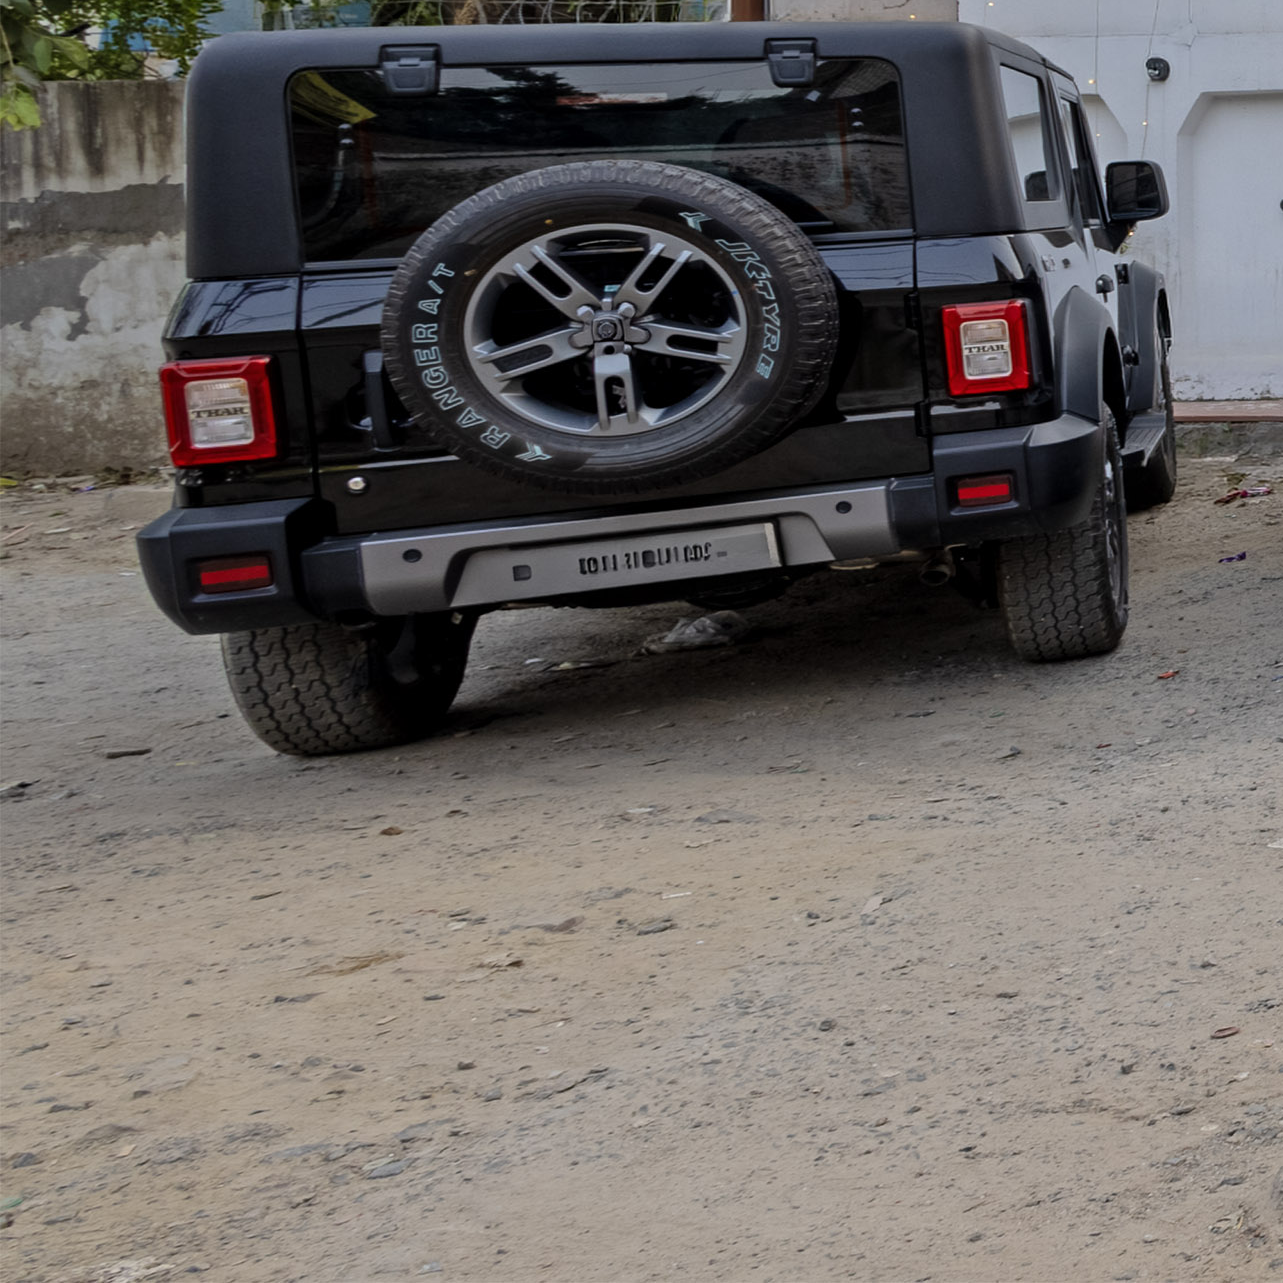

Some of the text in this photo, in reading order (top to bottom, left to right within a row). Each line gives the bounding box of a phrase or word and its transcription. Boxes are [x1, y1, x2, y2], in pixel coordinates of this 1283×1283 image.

[411, 262, 512, 451] RANGER A/T
[752, 278, 782, 381] TYRE
